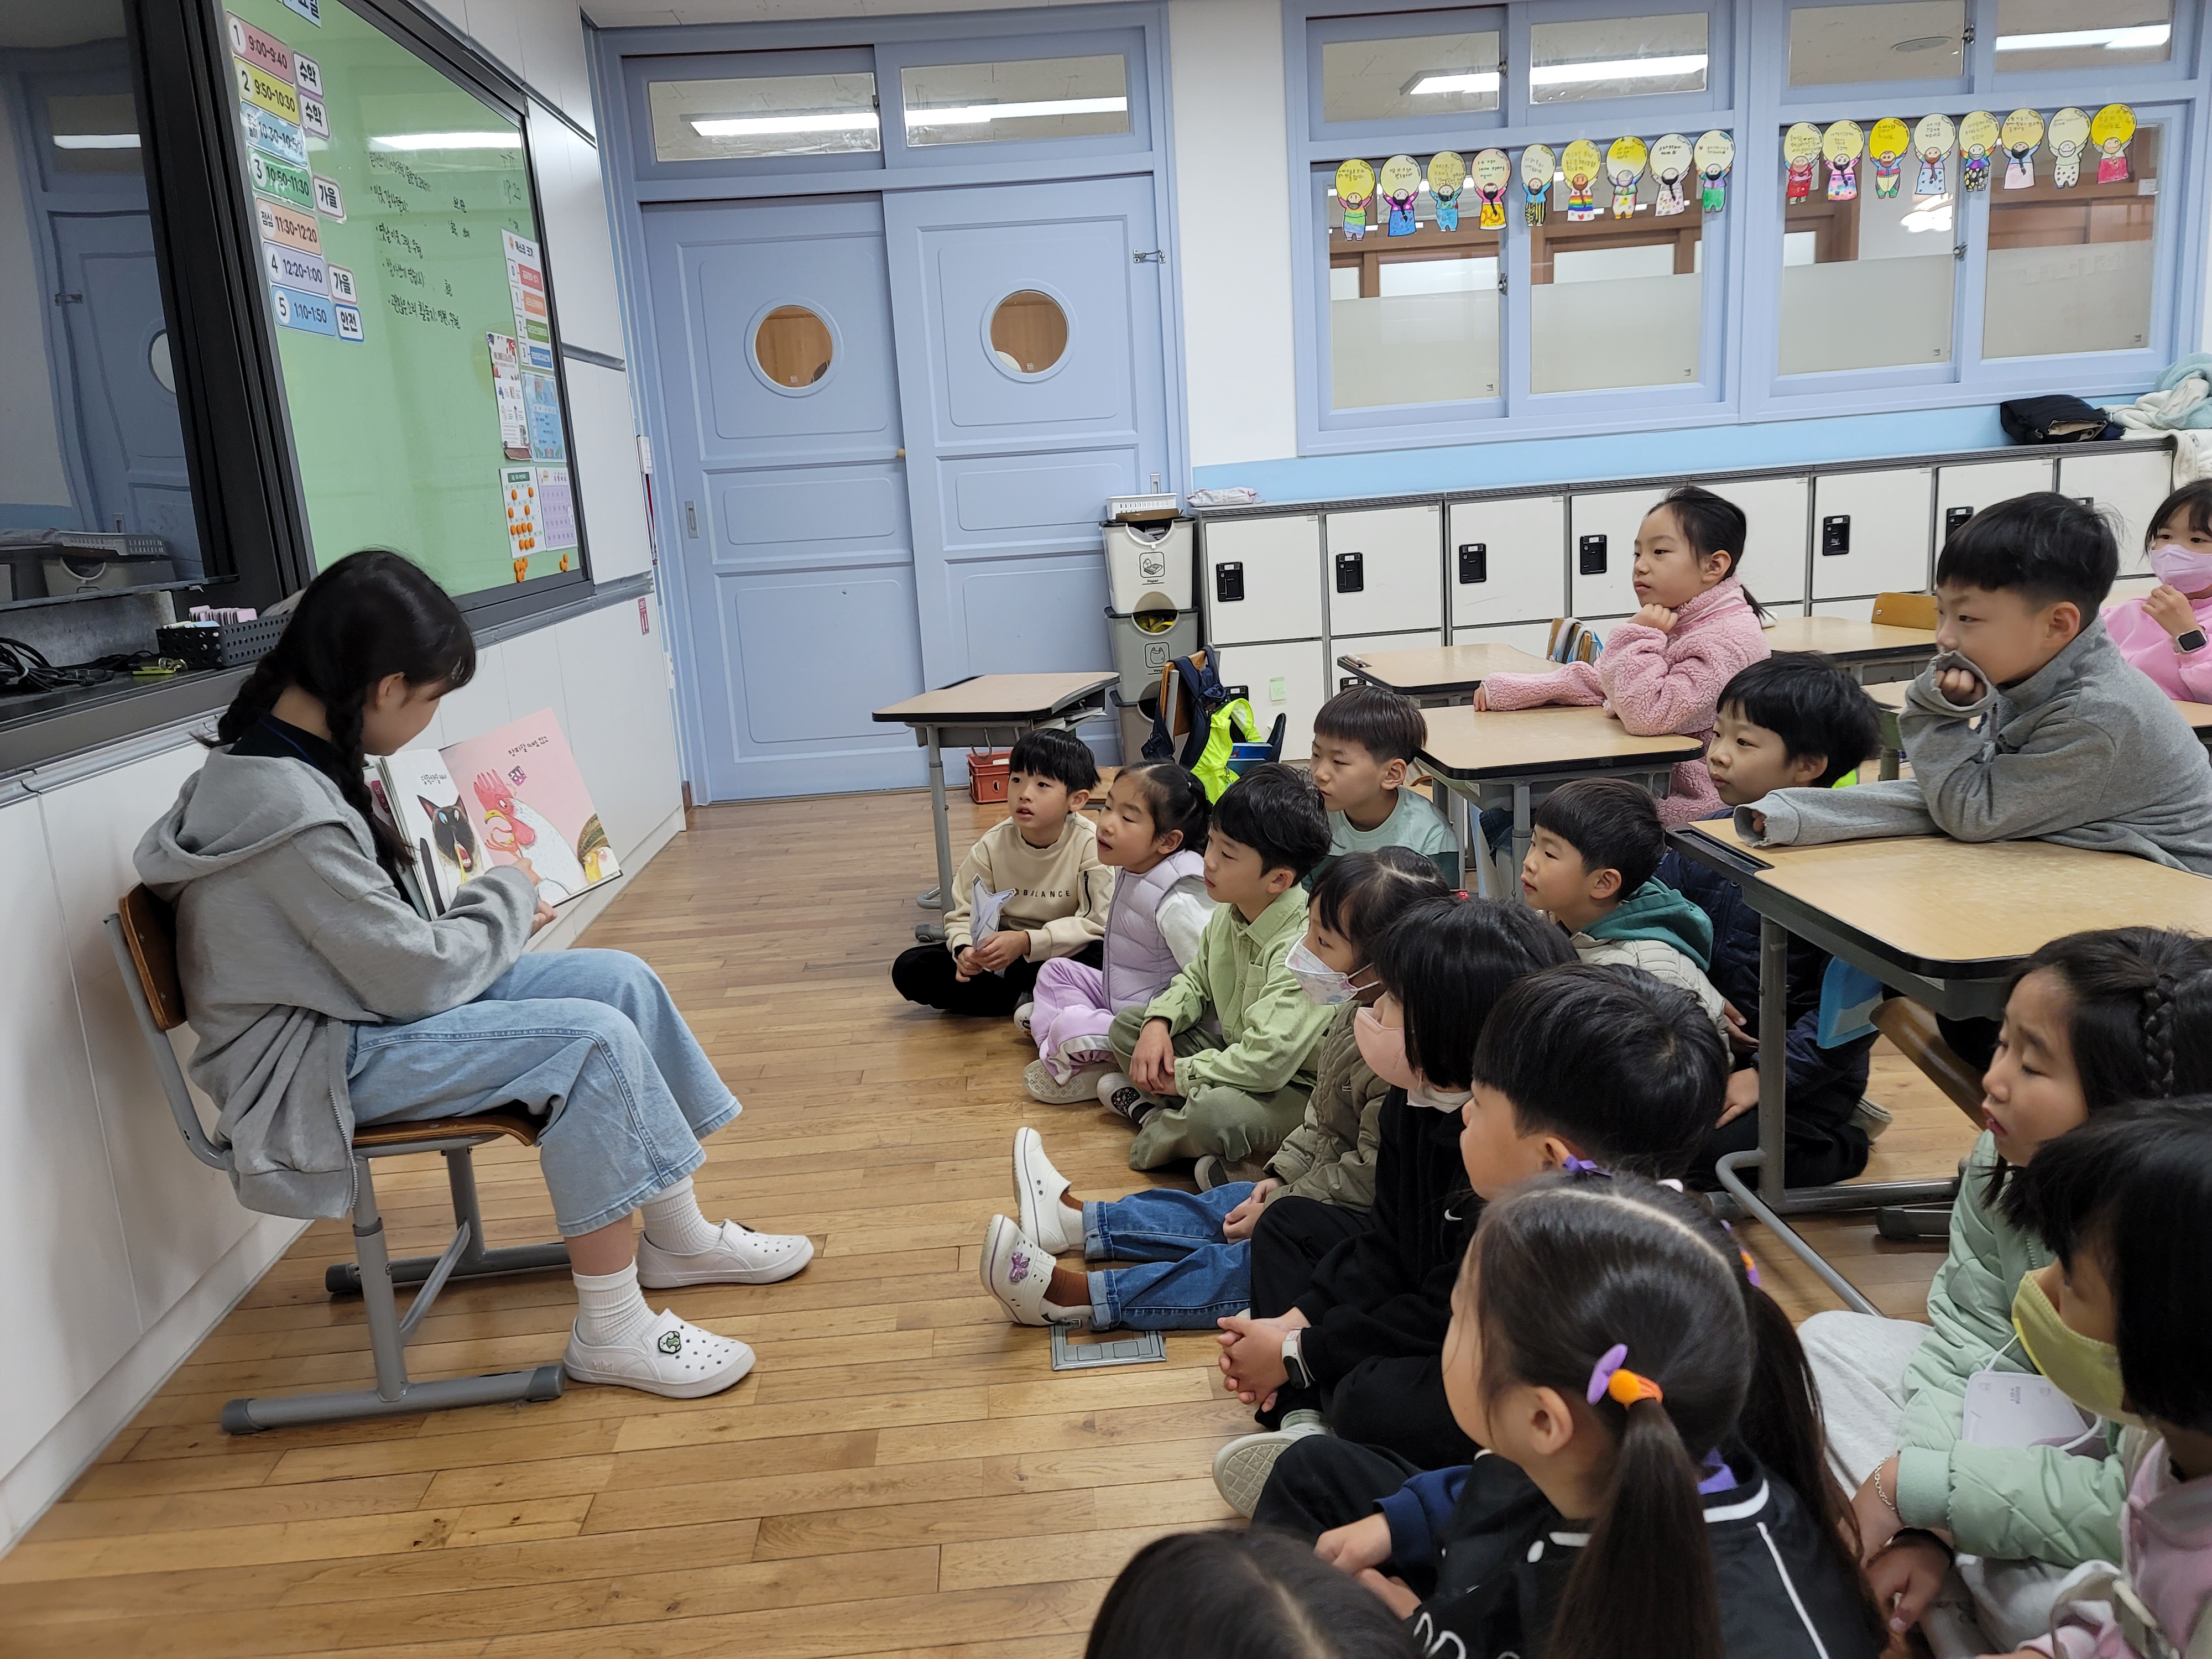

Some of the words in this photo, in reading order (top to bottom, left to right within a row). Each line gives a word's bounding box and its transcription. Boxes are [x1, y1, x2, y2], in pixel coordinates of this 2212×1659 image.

[234, 25, 241, 46] 1
[249, 35, 287, 69] 9:00-9:40
[300, 61, 317, 87] 수학
[242, 70, 250, 92] 2
[254, 79, 295, 112] 9:50-10:30
[305, 102, 322, 127] 수학
[254, 159, 262, 179] 3
[267, 166, 309, 196] 10:50-11:30
[319, 184, 338, 209] 가을
[261, 211, 274, 228] 점심
[275, 216, 317, 243] 11:30-12:20
[272, 254, 278, 274] 4
[283, 259, 322, 283] 12:20-1:00
[333, 273, 351, 295] 가을
[279, 297, 286, 316] 5
[294, 302, 327, 323] 1:10-1:50
[341, 311, 358, 332] 안전
[1023, 889, 1071, 898] BALANCE
